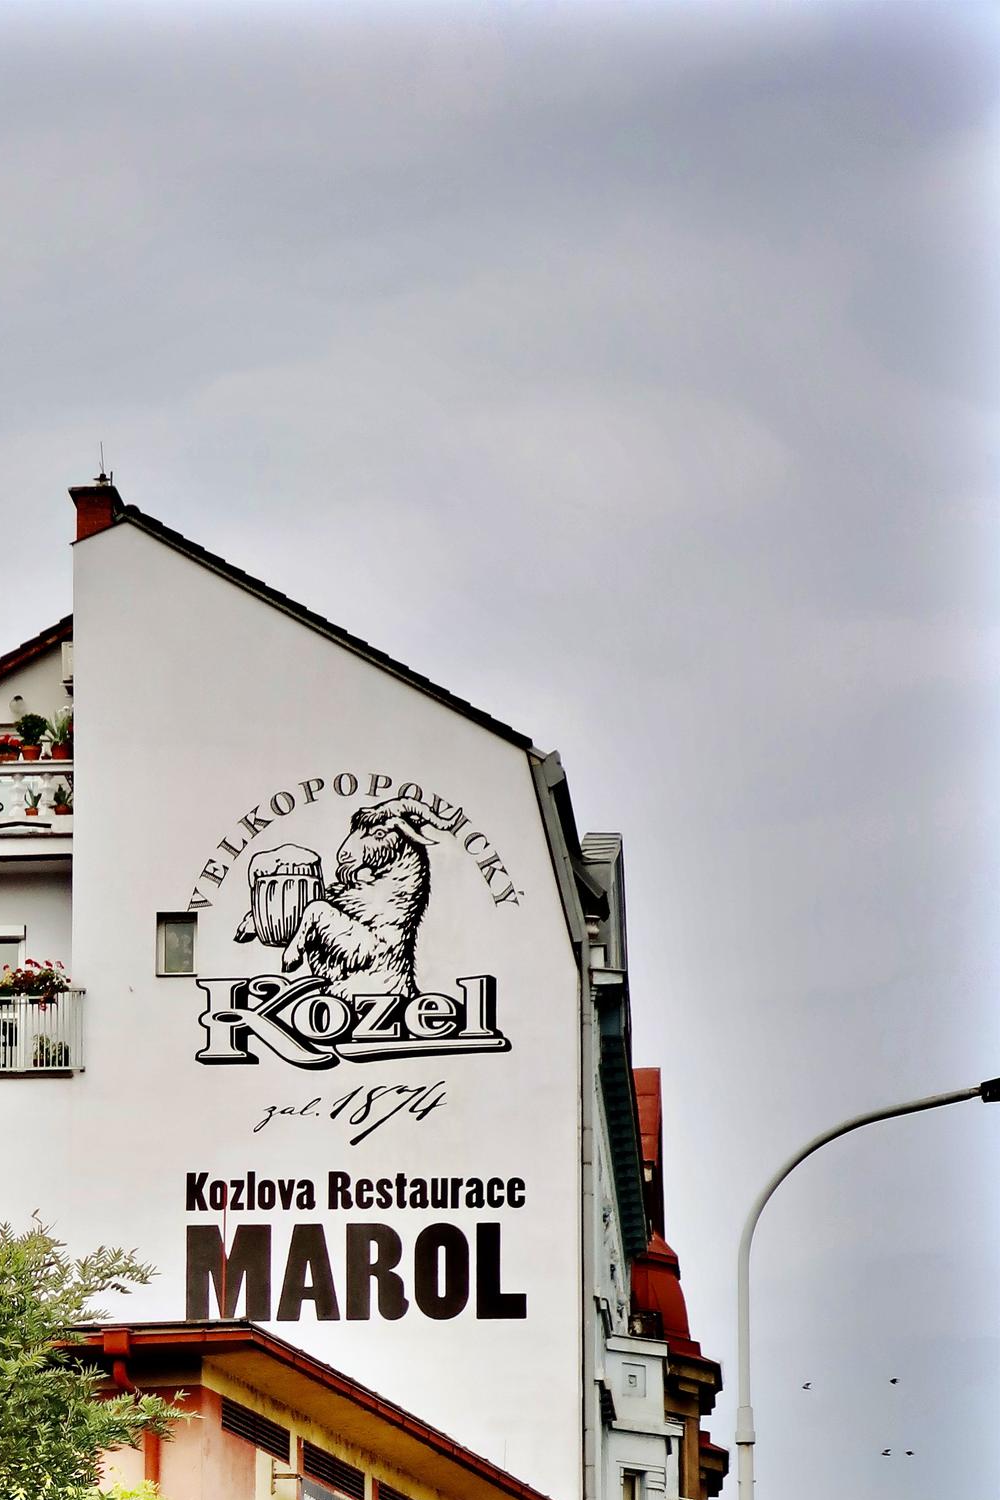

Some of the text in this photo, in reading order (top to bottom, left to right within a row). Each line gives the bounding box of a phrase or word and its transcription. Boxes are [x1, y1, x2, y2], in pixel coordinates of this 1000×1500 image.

[187, 772, 525, 912] VELKOPOPOVICKÝ
[195, 973, 512, 1071] Kozel
[253, 1080, 446, 1146] zal. 1874
[185, 1171, 527, 1212] Kozlova Restaurace
[185, 1222, 527, 1321] MAROL
